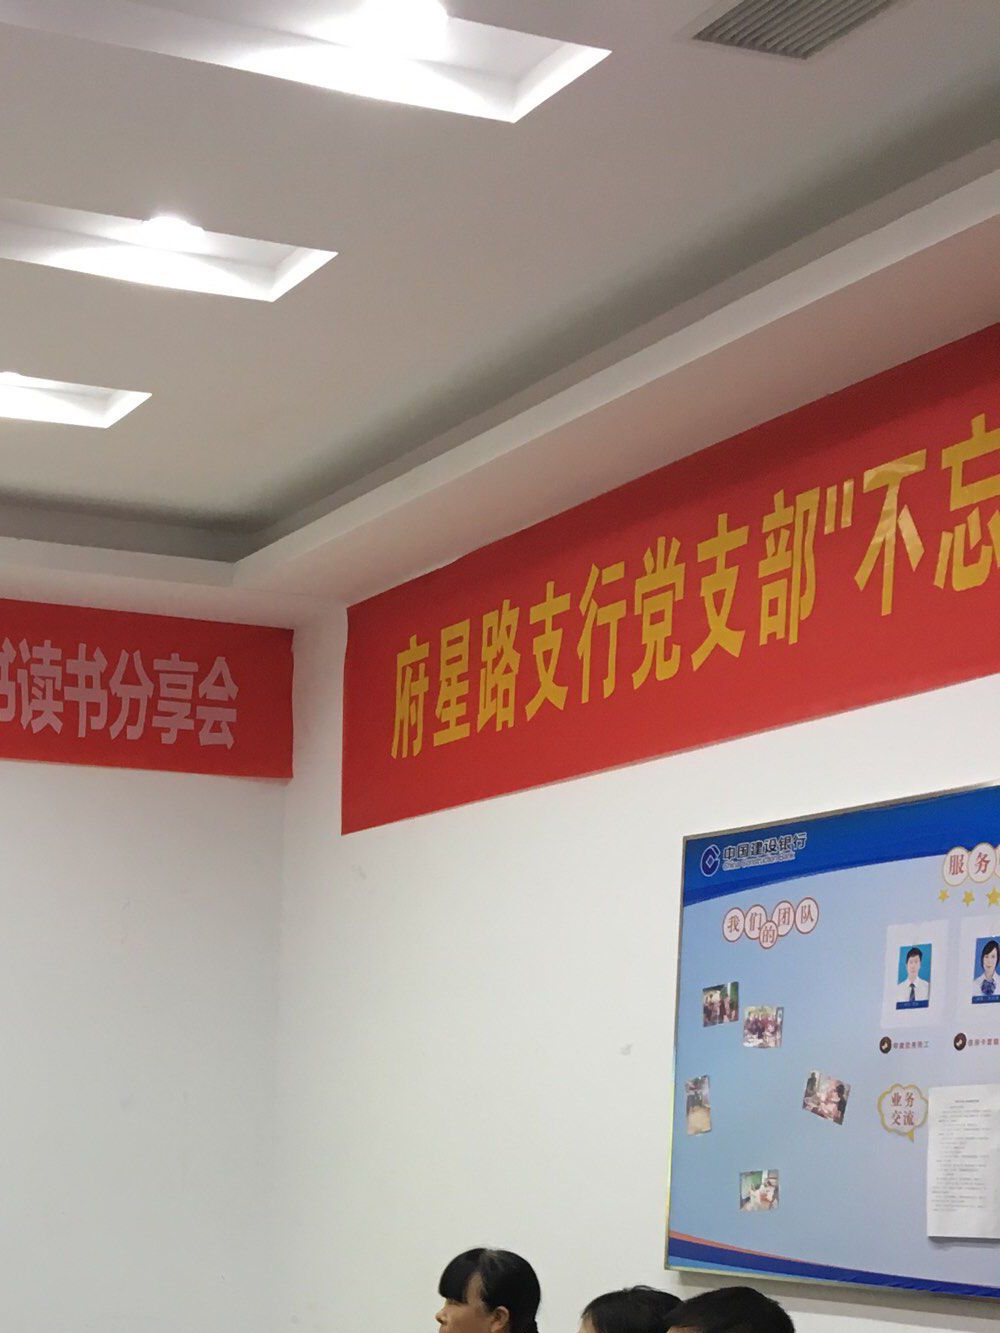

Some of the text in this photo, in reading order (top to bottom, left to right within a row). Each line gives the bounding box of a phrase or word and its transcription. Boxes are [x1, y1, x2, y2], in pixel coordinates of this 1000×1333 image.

[723, 832, 807, 860] 中国建设银行
